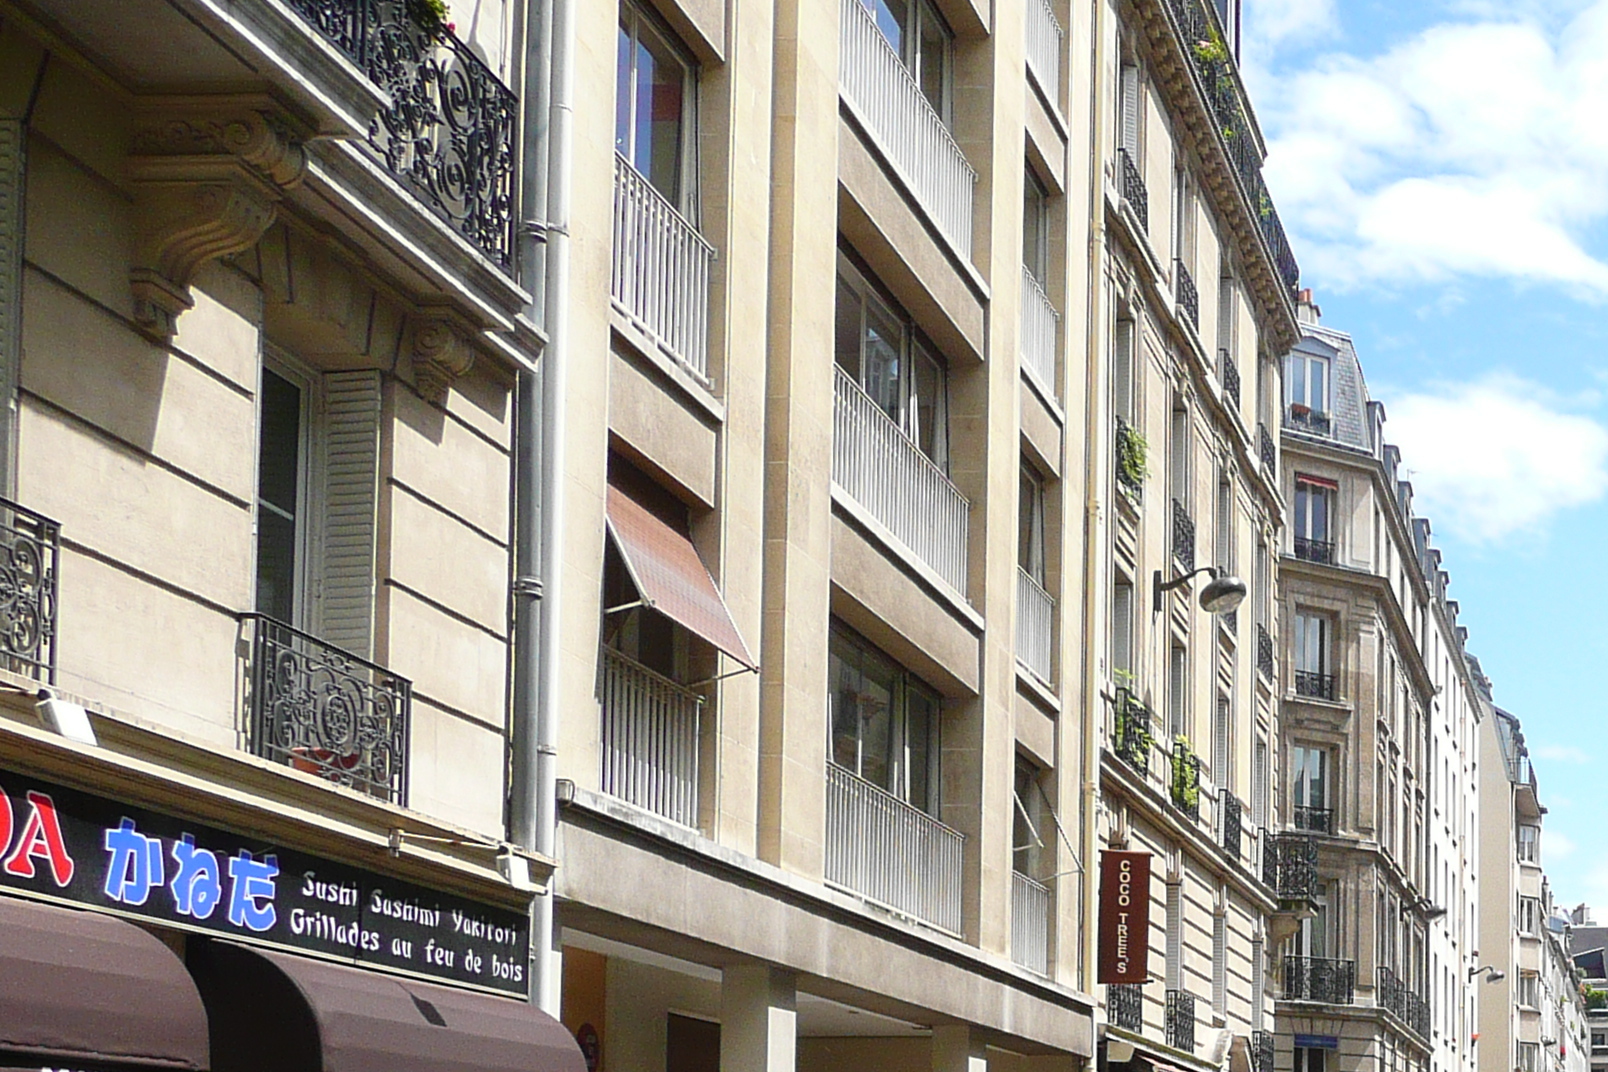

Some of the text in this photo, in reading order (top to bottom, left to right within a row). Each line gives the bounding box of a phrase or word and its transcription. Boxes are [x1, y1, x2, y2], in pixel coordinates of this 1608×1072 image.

[0, 784, 74, 887] A
[104, 816, 280, 932] かねだ
[302, 871, 358, 906] Sushi
[452, 909, 517, 945] Yakitori
[1118, 860, 1131, 906] COCO
[291, 909, 523, 982] Grillades au feu de bois
